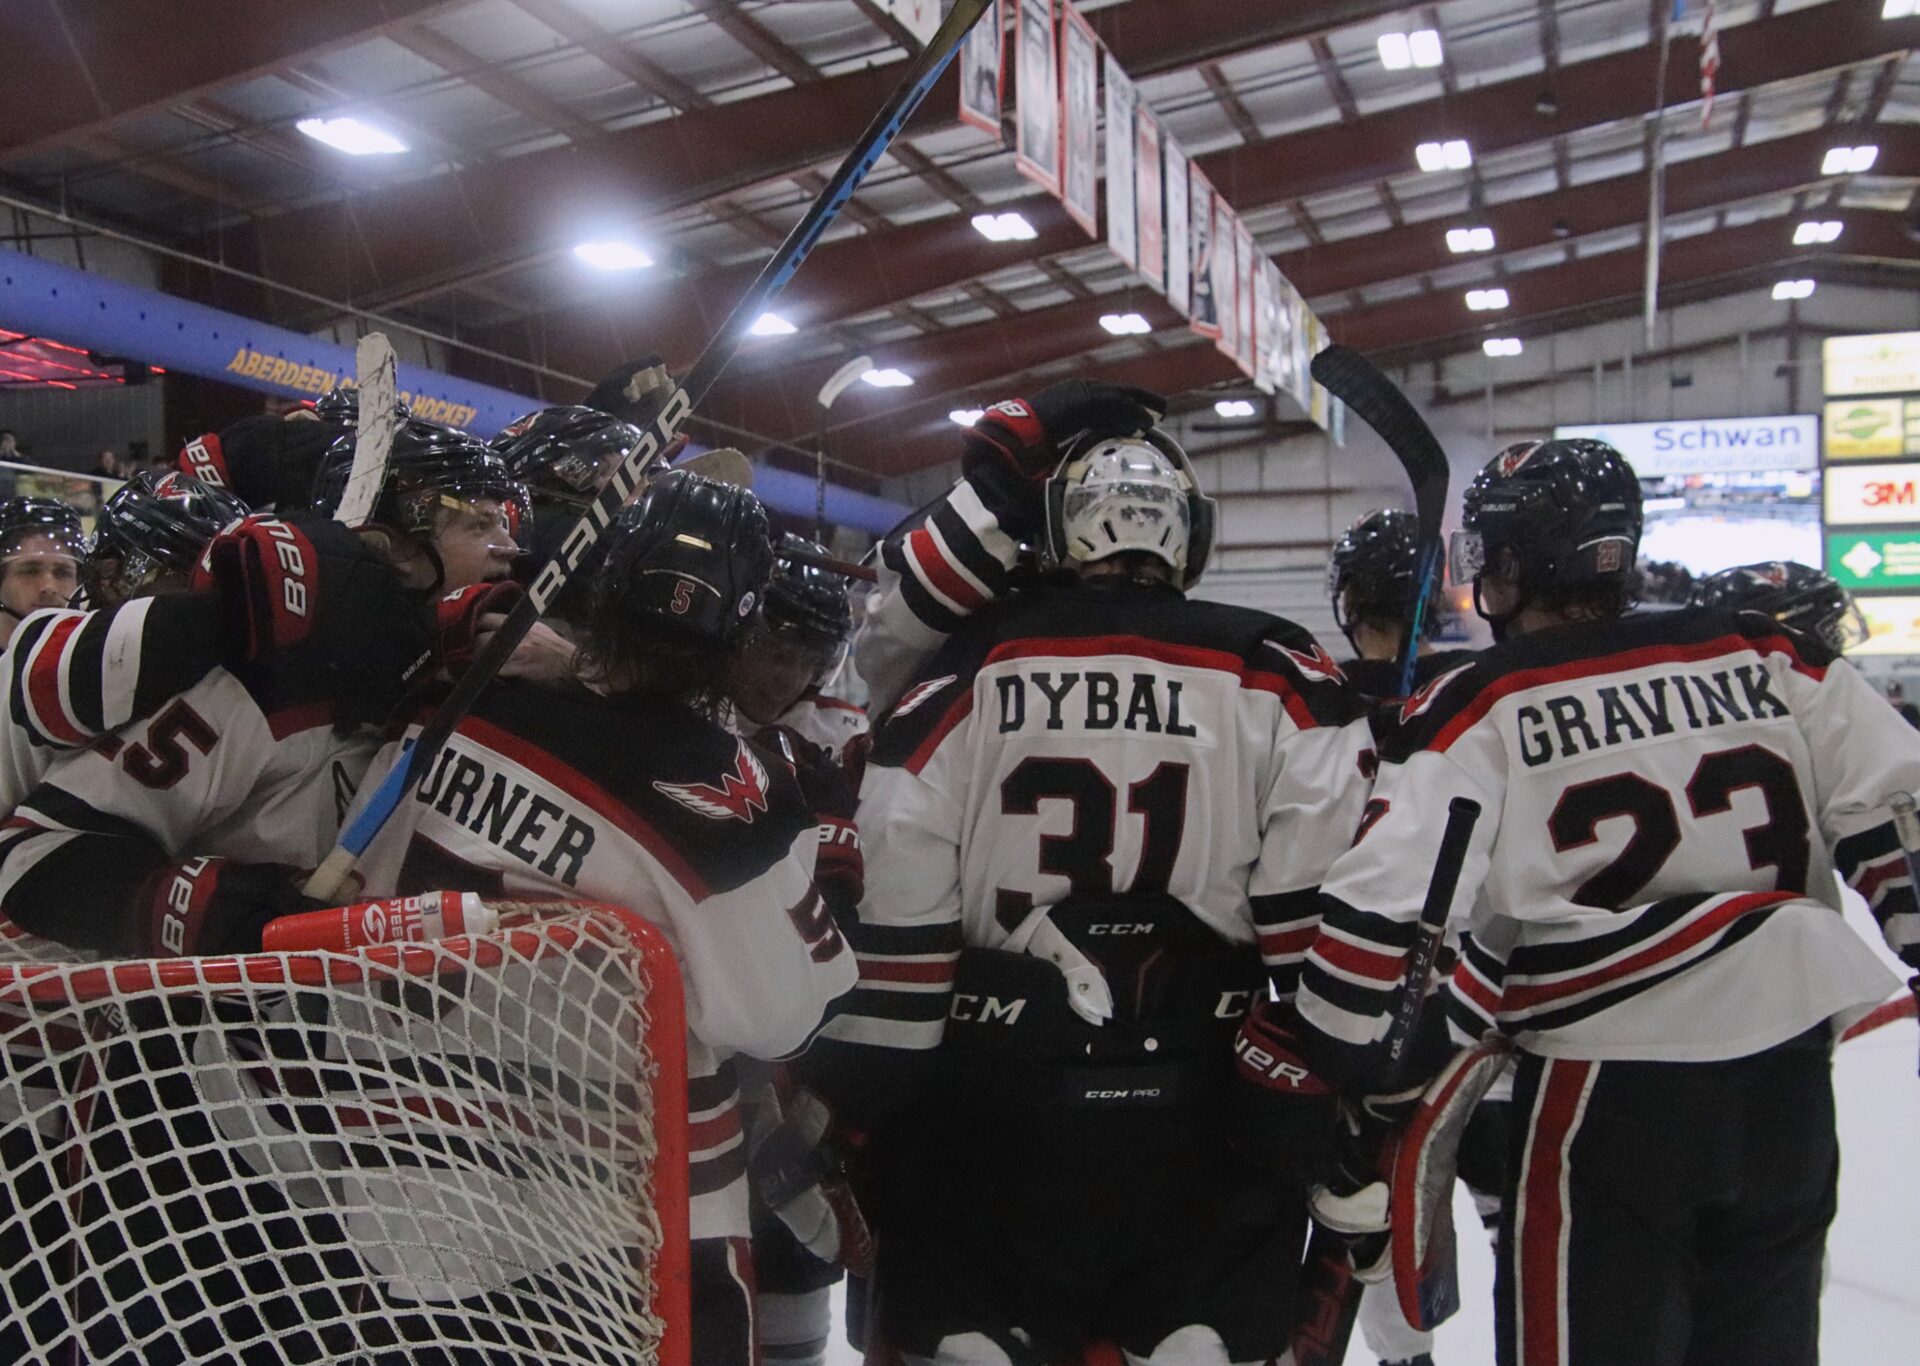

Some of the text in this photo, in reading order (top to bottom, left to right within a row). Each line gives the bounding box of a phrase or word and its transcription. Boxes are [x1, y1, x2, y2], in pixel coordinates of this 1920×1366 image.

[225, 349, 478, 427] ABERDEEN HOCKEY
[1653, 424, 1800, 451] Schwan
[1862, 481, 1914, 506] 3M
[670, 579, 695, 615] 5
[996, 672, 1196, 738] DYBAL
[1517, 664, 1791, 767] GRAVINK
[403, 738, 596, 888] URNER
[995, 756, 1190, 935] 31
[1547, 743, 1811, 914] 23
[1088, 923, 1154, 936] CCM
[1085, 1089, 1160, 1098] CCM PRO
